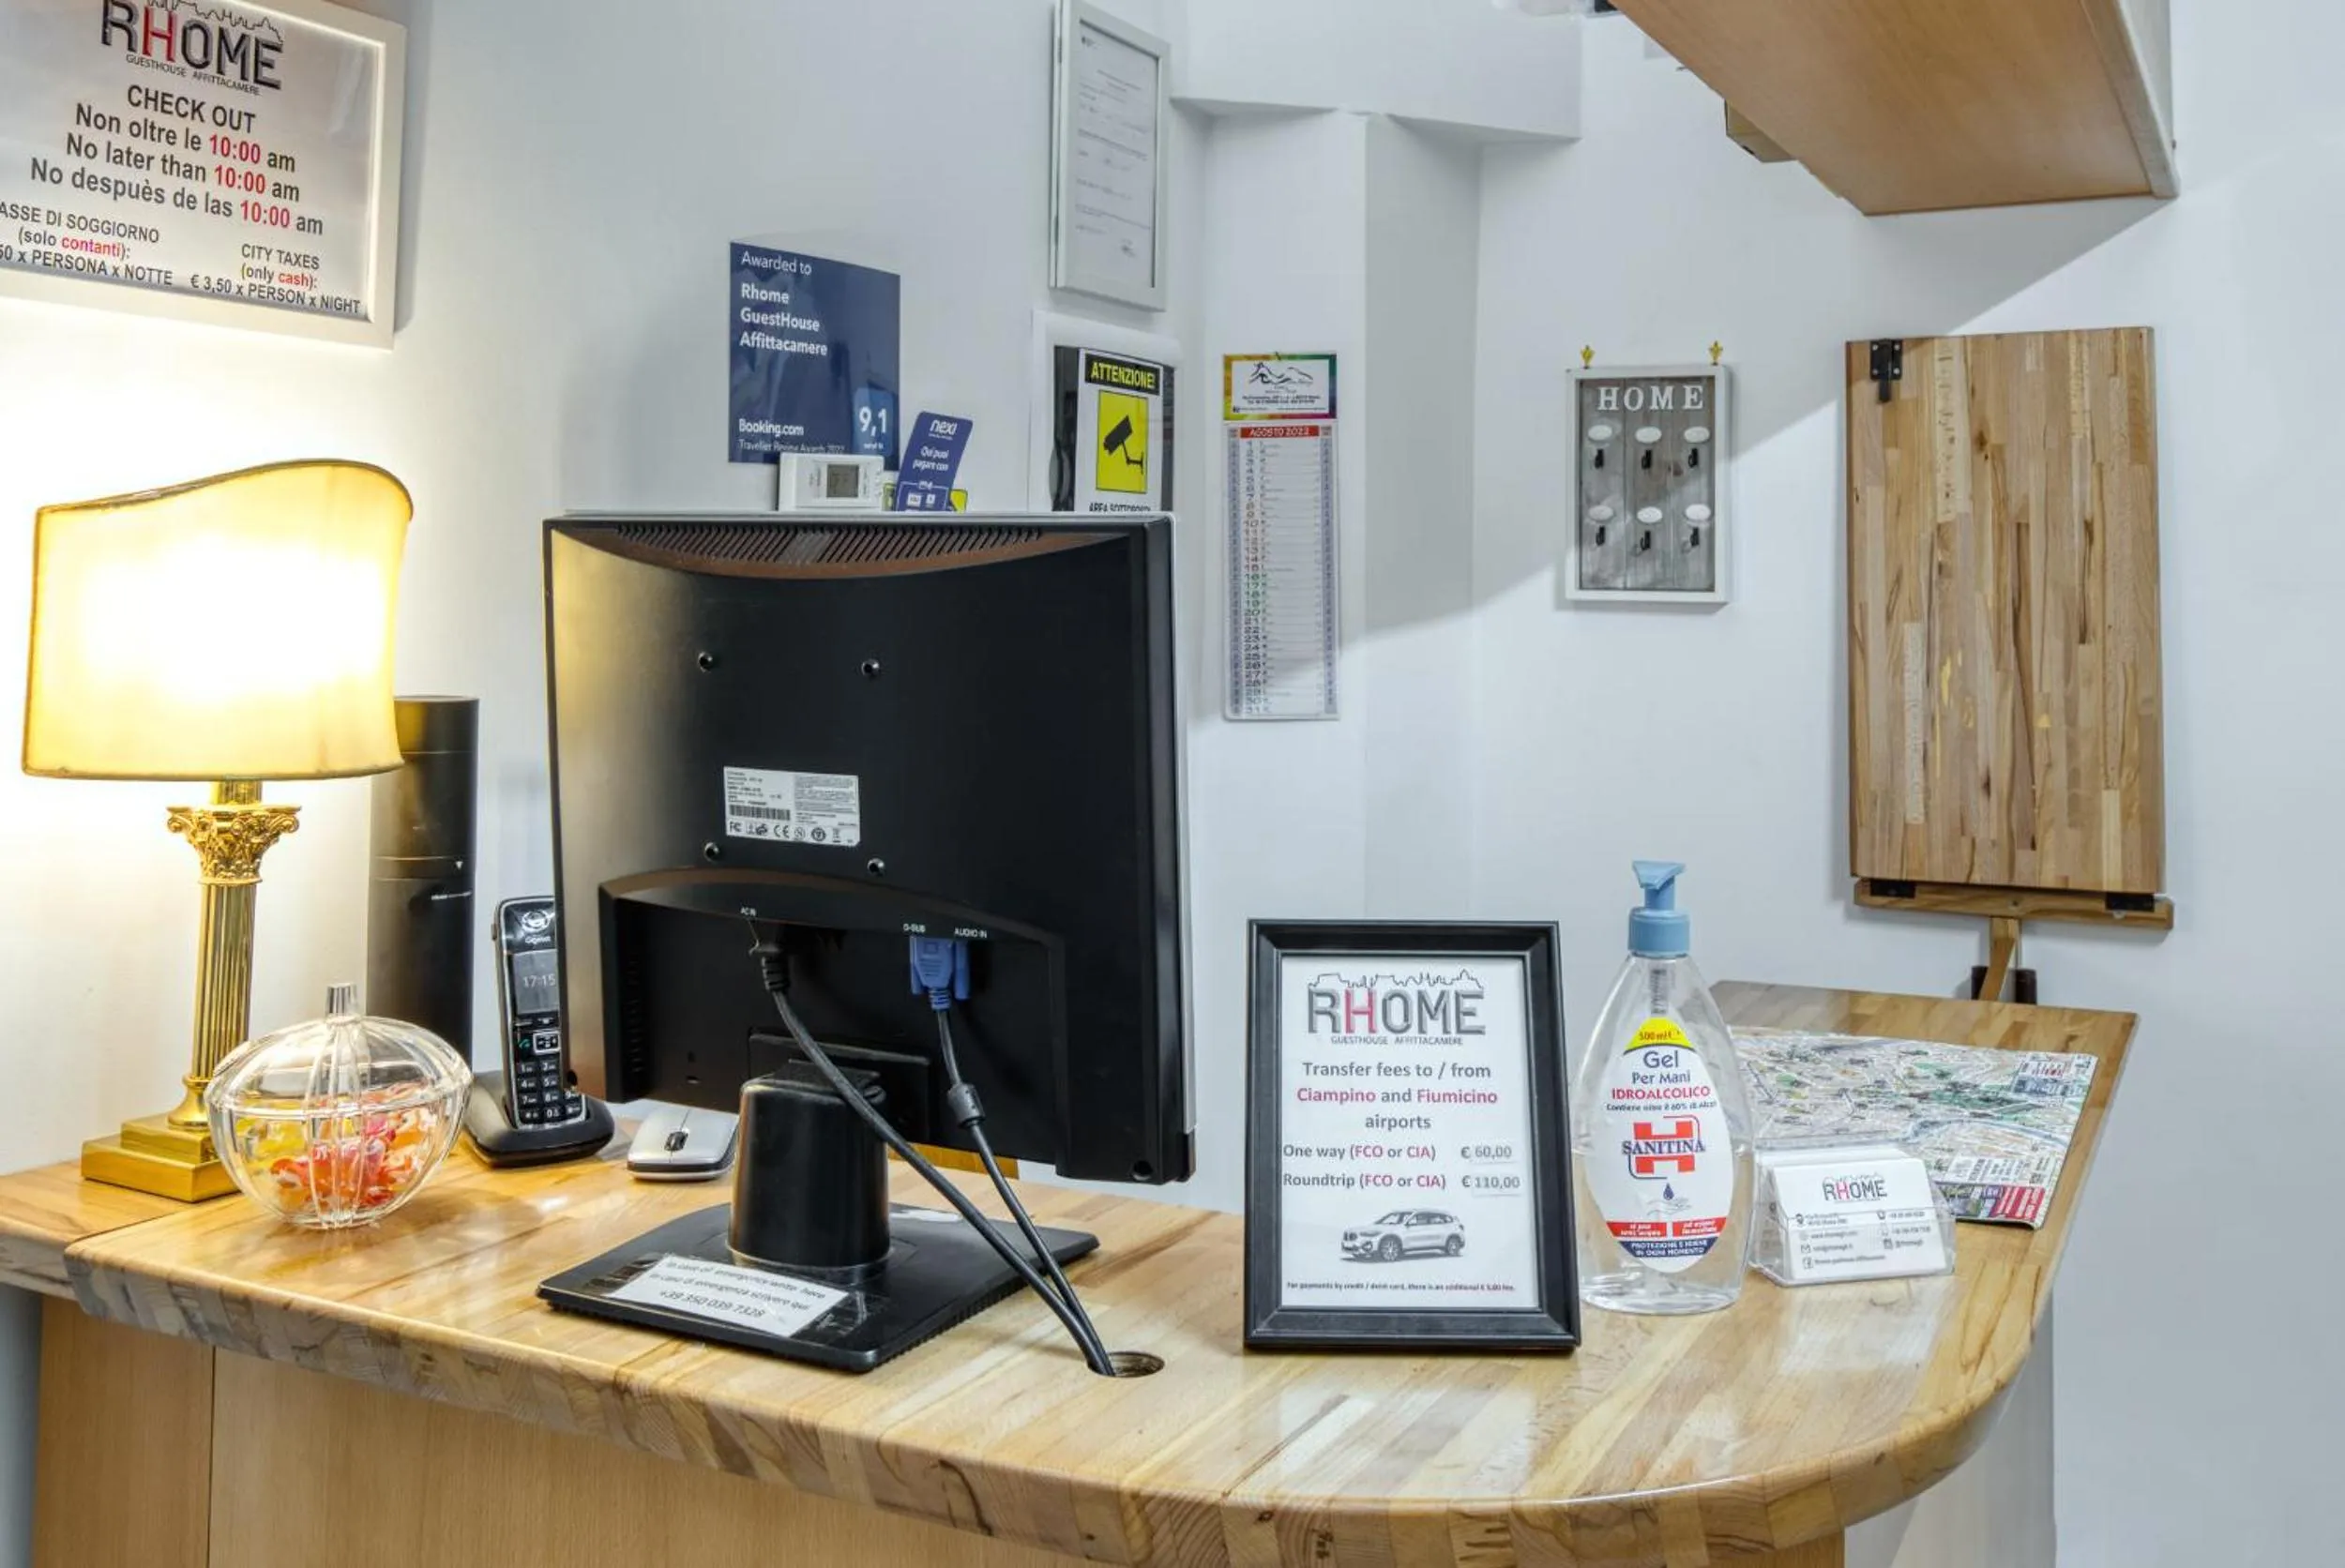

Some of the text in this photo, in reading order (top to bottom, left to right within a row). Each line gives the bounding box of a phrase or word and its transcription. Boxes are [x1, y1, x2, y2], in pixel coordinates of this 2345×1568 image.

[101, 0, 283, 90] RHOME
[126, 53, 260, 96] GUESTHOUSE AFFITTACAMERE
[128, 84, 256, 134] CHECK OUT
[76, 102, 295, 173] Non oltre le 10:00 am
[67, 132, 299, 203] No later than 10:00 am
[31, 158, 324, 235] No despuès de las 10:00 am
[46, 209, 62, 227] DI
[67, 213, 159, 244] SOGGIORNO
[19, 226, 130, 261] (solo contanti):
[241, 243, 320, 270] CITY TAXES
[741, 249, 812, 276] Awarded to
[32, 249, 108, 276] PERSONA
[124, 264, 173, 285] NOTTE
[204, 275, 233, 294] 3,50
[248, 282, 306, 306] PERSON
[320, 294, 361, 314] NIGHT
[241, 263, 318, 292] (only cash):
[741, 282, 790, 304] Rhome
[740, 306, 821, 332] GuestHouse
[739, 330, 828, 356] Affittacamere
[1597, 385, 1704, 412] HOME
[738, 418, 804, 437] Booking.com
[858, 406, 887, 438] 9,1
[1309, 988, 1486, 1035] RHOME
[1331, 1035, 1463, 1046] GUESTHOUSE AFFITTACAMERE
[1302, 1062, 1371, 1077] Transfer
[1376, 1062, 1411, 1077] fees
[1415, 1063, 1432, 1078] to
[1451, 1063, 1491, 1078] from
[1643, 1049, 1679, 1069] Gel
[1632, 1069, 1691, 1085] Per Mani
[1297, 1087, 1498, 1106] Ciampino and Fiumicino
[1611, 1086, 1711, 1100] IDROALCOLICO
[1365, 1113, 1431, 1131] airports
[1283, 1143, 1512, 1162] One way (FCO or CIA) € 60,00
[1622, 1138, 1706, 1155] SANITINA
[1283, 1173, 1520, 1193] Roundtrip (FCO or CIA) € 110,00
[1823, 1178, 1888, 1201] RHOME
